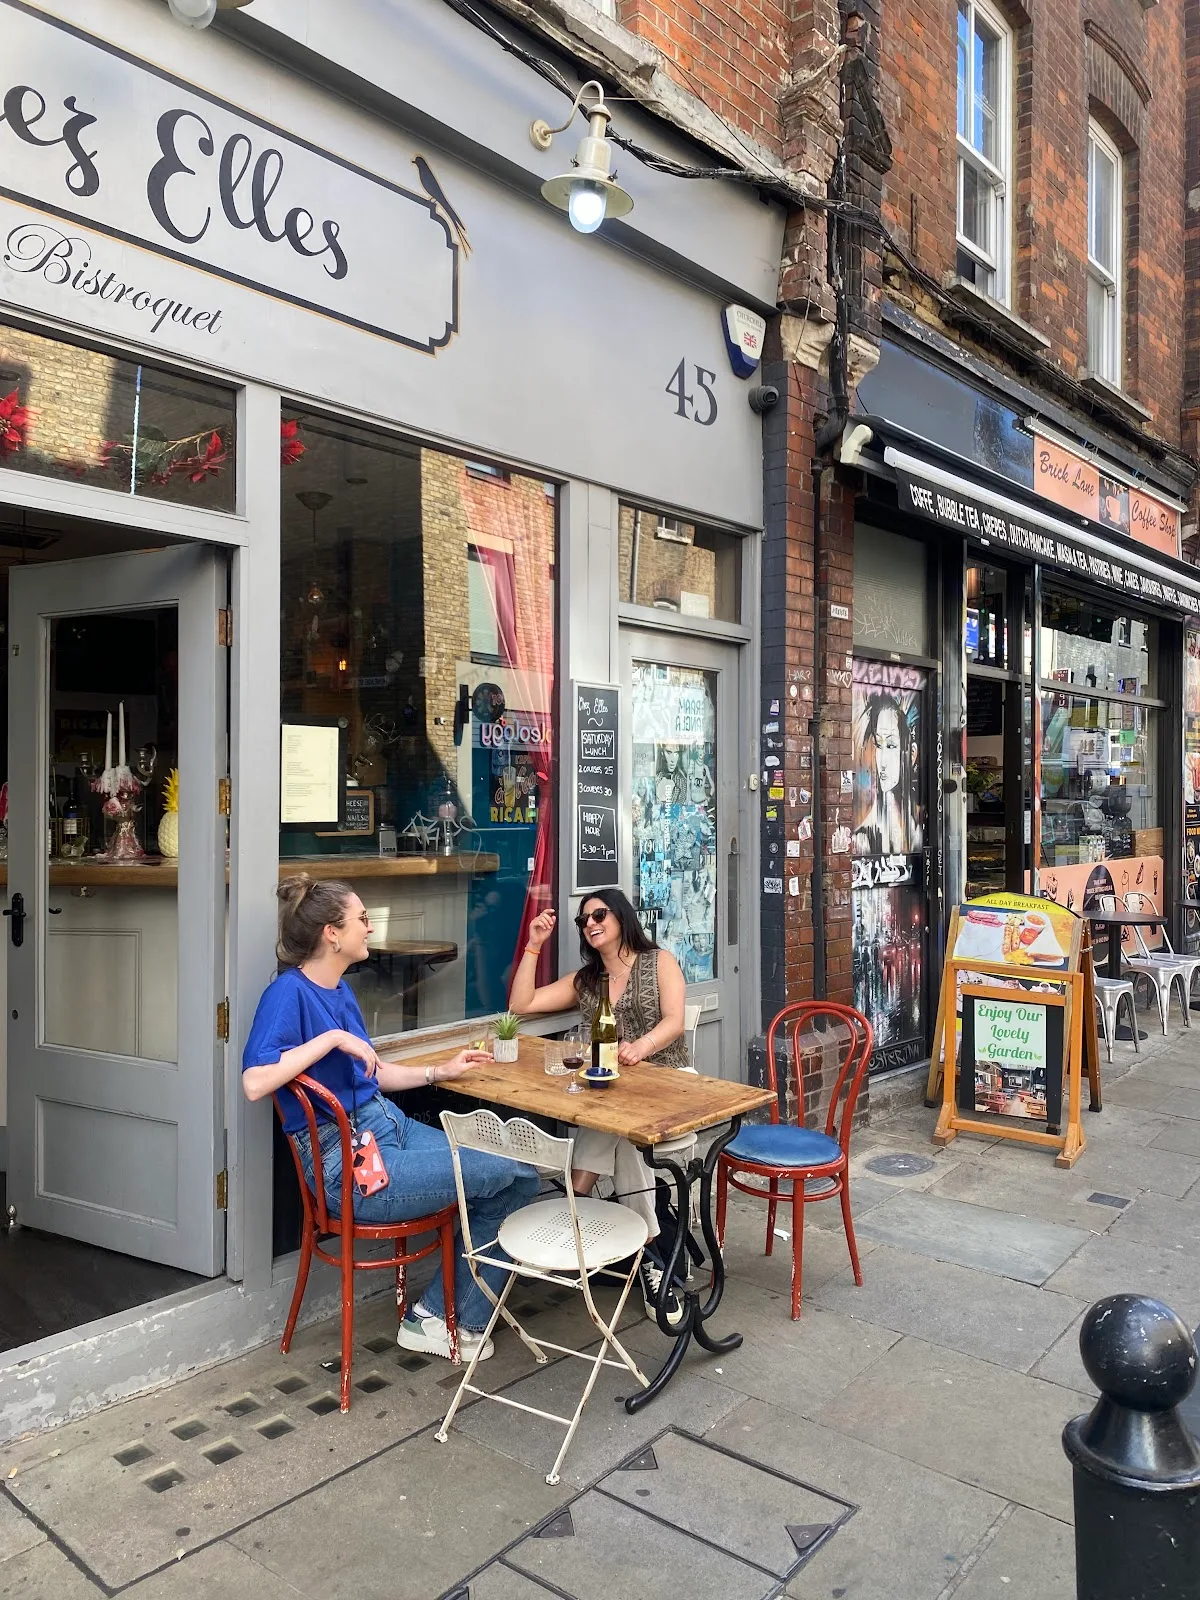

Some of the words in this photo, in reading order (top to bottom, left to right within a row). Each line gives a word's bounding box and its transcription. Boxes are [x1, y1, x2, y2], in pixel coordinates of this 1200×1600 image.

[147, 108, 348, 280] Elles
[3, 223, 222, 335] Bistroquet
[665, 357, 718, 426] 45
[1040, 451, 1069, 484] Brick
[1072, 467, 1095, 497] Lane
[965, 505, 981, 531] TEA
[1131, 500, 1157, 531] Coffee
[1160, 512, 1177, 541] Shop
[582, 732, 613, 748] SATURDAY
[584, 747, 607, 757] LUNCH
[604, 765, 614, 776] 25
[603, 787, 613, 797] 30
[582, 811, 605, 829] HAPPY
[585, 826, 601, 837] HOUR
[1186, 827, 1197, 837] FOOD
[1000, 899, 1013, 907] DAY
[1013, 901, 1050, 911] BREAKFAST
[978, 1004, 1012, 1023] Enjoy
[1016, 1007, 1043, 1022] Our
[990, 1024, 1030, 1045] Lovely
[987, 1043, 1033, 1060] Garden
